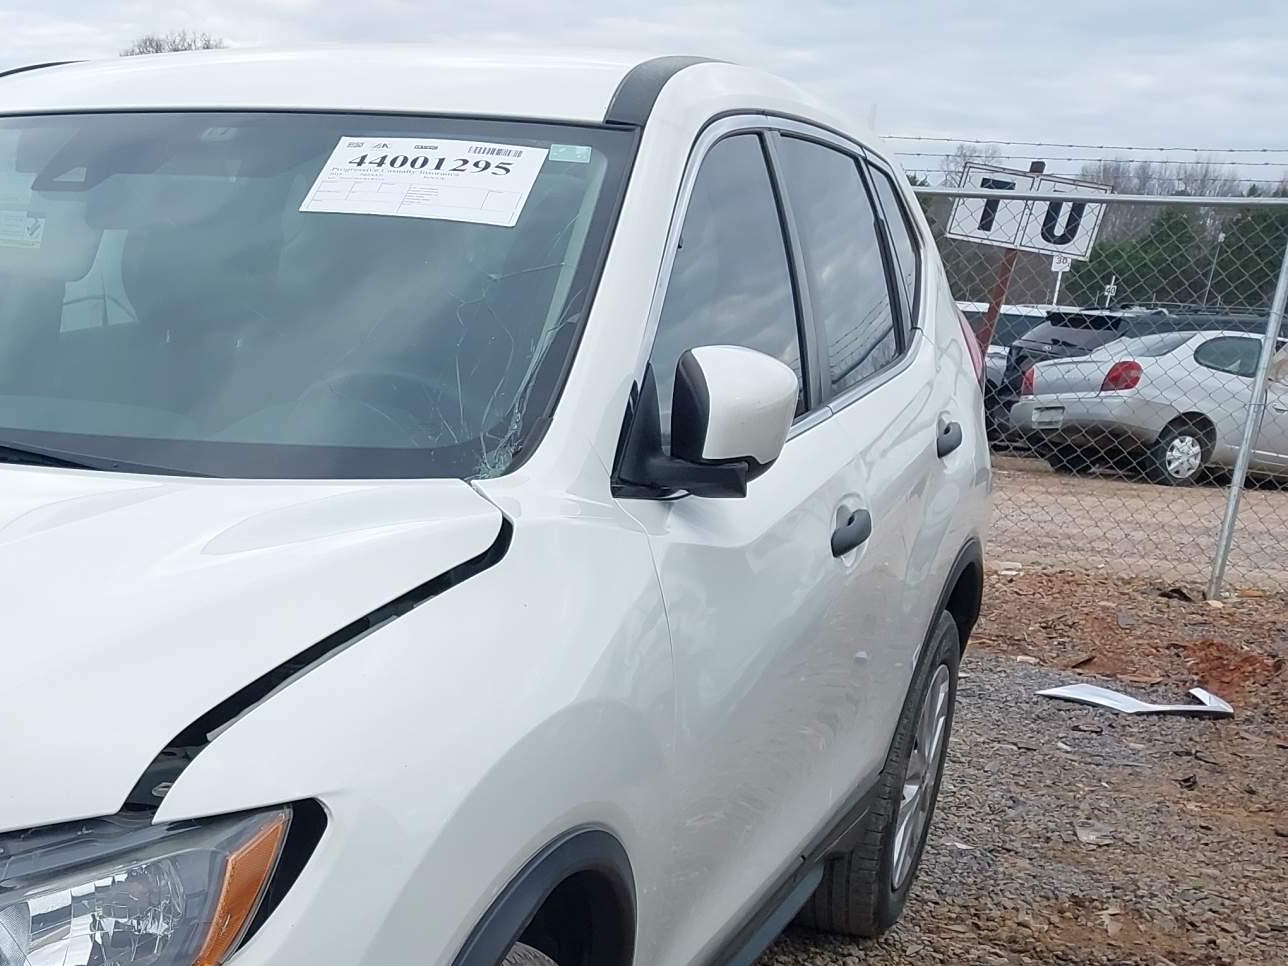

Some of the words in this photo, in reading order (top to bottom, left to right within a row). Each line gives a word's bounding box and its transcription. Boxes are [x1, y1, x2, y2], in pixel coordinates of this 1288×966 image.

[348, 153, 515, 176] 44001295
[977, 177, 1016, 232] T
[1041, 189, 1086, 245] U
